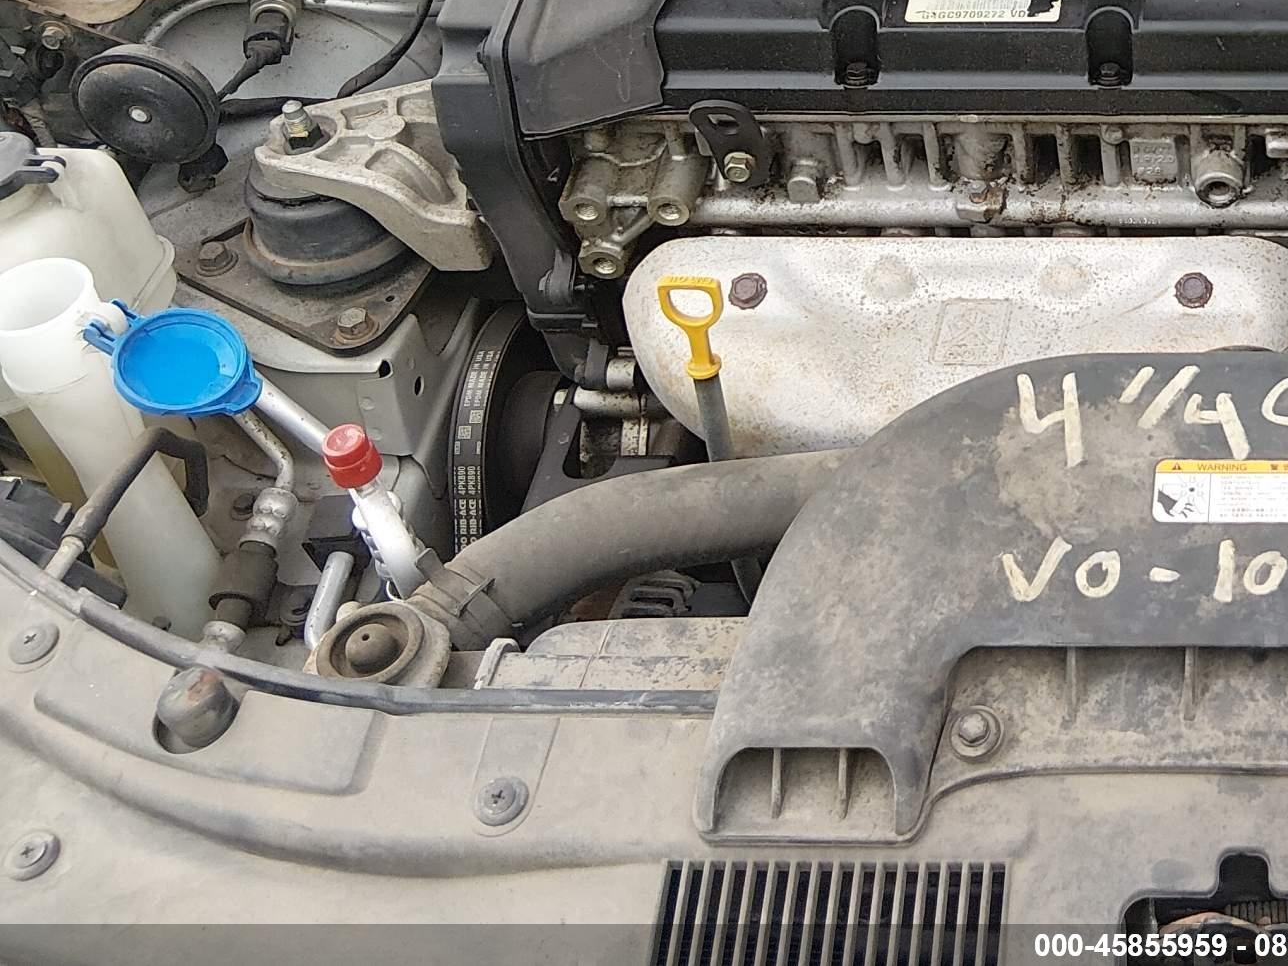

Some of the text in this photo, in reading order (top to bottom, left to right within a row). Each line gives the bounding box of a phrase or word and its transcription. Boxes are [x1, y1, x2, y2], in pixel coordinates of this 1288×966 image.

[467, 371, 478, 389] MADE
[477, 371, 488, 389] MADE
[1197, 463, 1248, 471] WARNING
[459, 498, 467, 535] RIB-ACE
[469, 498, 477, 535] RIB-ACE
